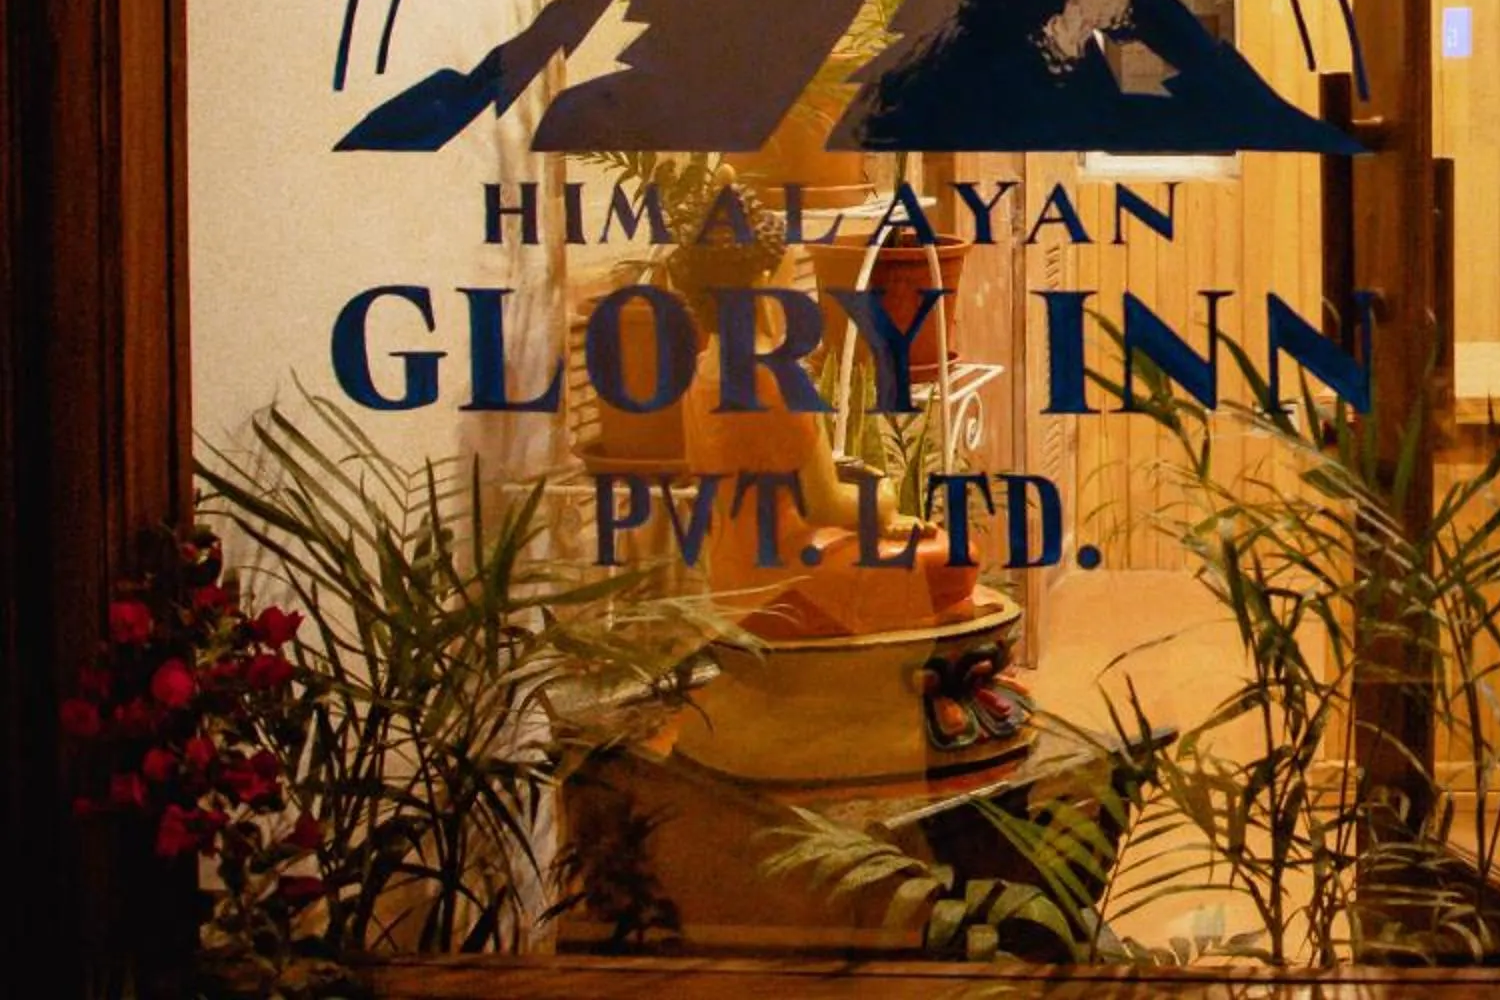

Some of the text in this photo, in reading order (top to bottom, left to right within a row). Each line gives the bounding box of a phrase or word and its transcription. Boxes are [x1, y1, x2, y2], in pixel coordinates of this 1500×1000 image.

[483, 181, 1176, 246] HIMALAYAN
[331, 284, 1383, 415] GLORY INN
